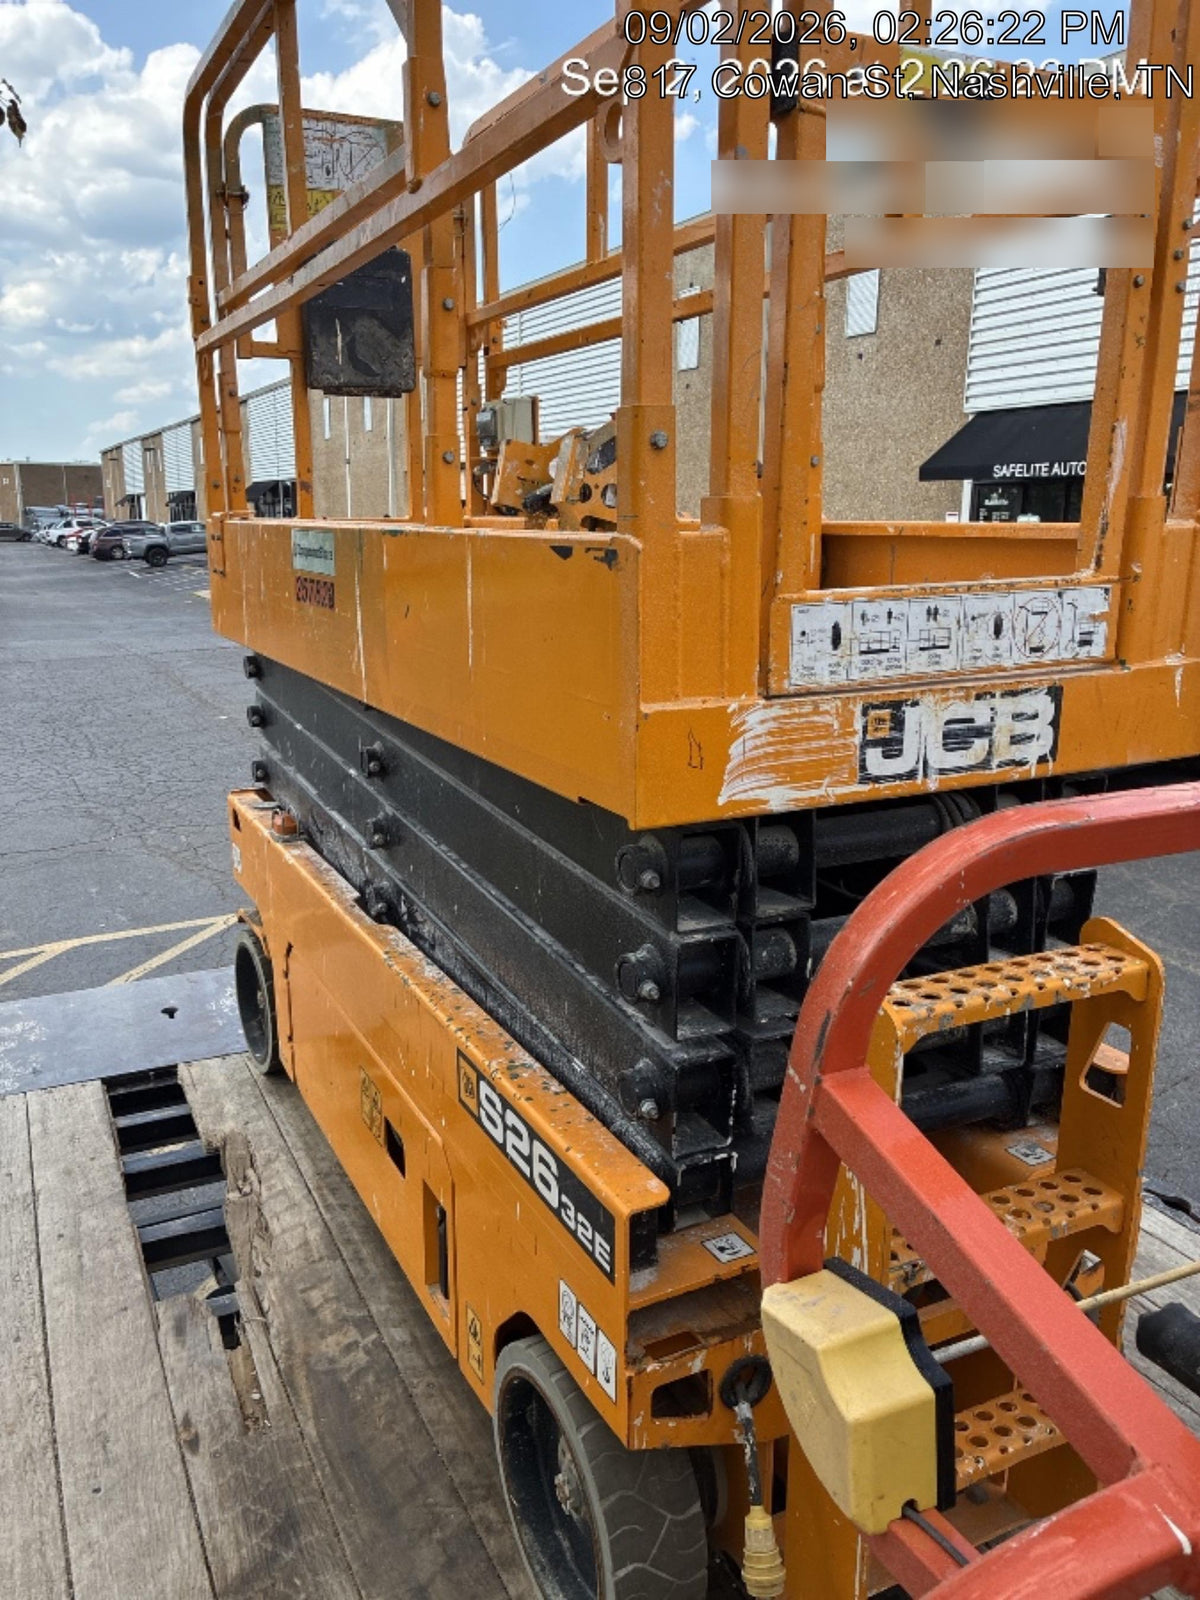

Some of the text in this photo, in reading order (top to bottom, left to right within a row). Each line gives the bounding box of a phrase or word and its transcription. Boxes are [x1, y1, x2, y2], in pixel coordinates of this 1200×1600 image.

[993, 459, 1087, 478] SAFELITE AUTO
[864, 692, 1057, 776] JCB
[478, 1079, 560, 1210] S26
